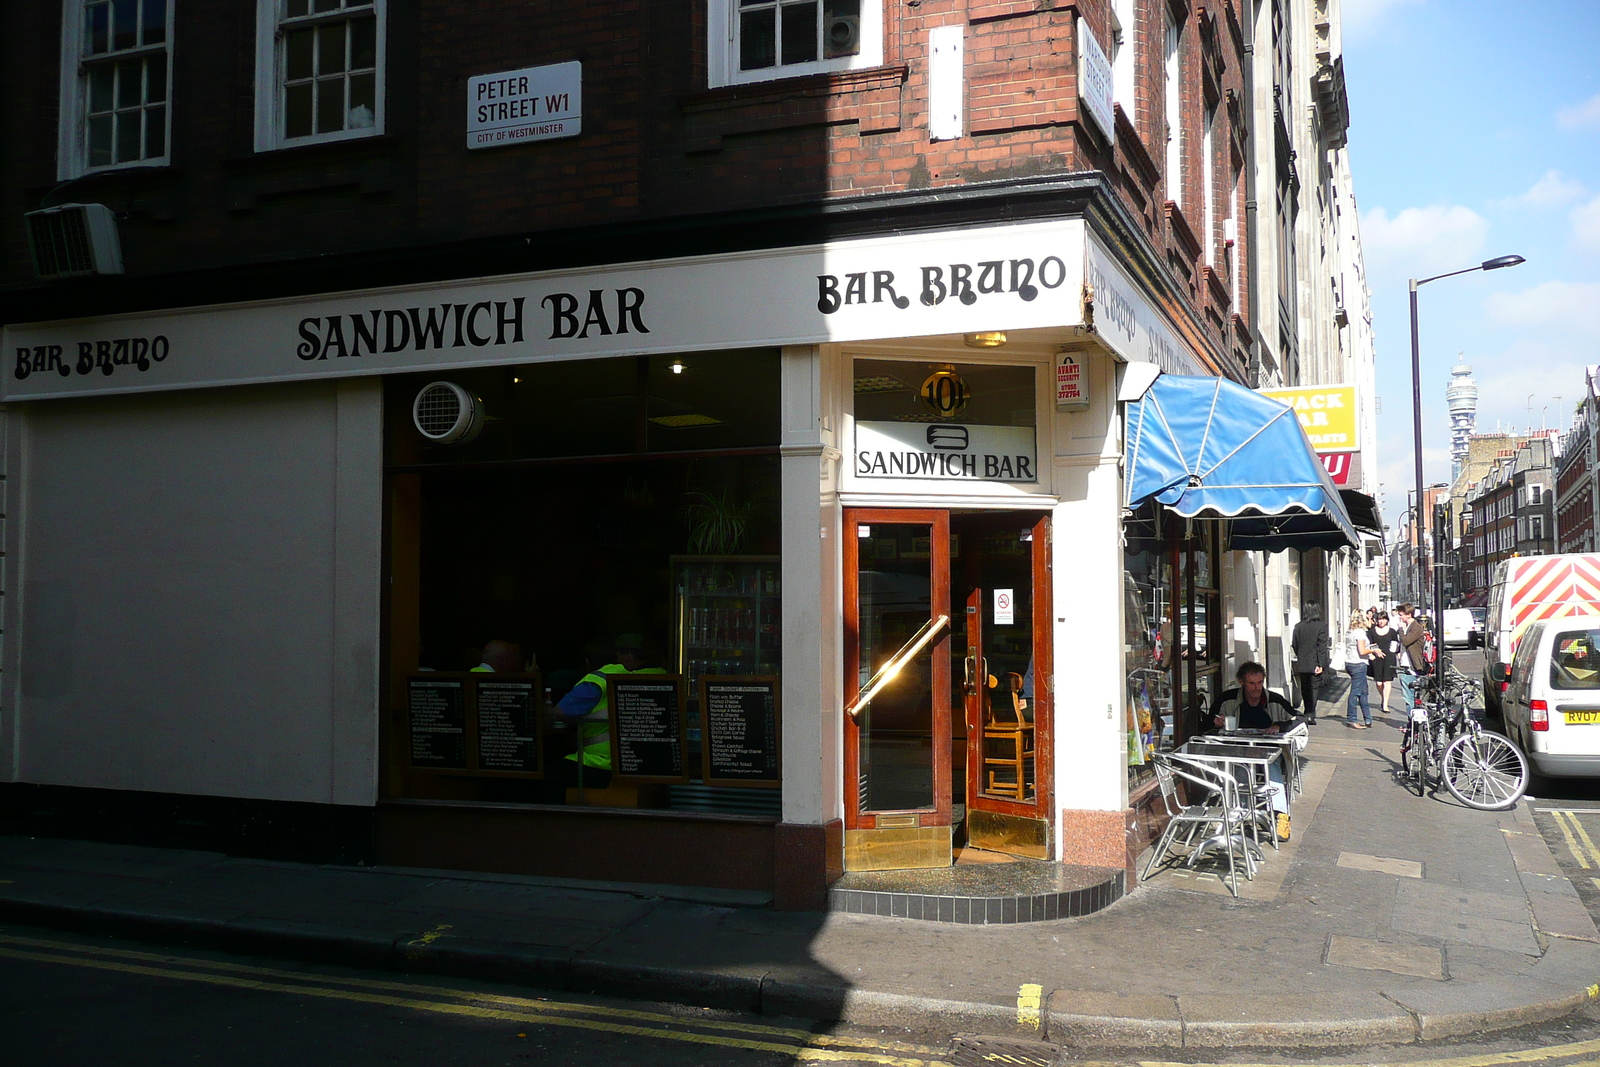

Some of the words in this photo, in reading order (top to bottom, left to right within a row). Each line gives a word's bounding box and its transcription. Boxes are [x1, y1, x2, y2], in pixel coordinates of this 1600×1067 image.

[478, 76, 528, 101] PETER
[1086, 57, 1104, 101] STREET
[478, 97, 539, 123] STREET
[545, 93, 569, 113] W1
[477, 133, 494, 143] CITY
[496, 131, 506, 141] OF
[507, 123, 563, 139] WESTMINSTER
[815, 270, 911, 315] BAR
[919, 255, 1067, 307] BRUNO
[297, 297, 526, 361] SANDWICH
[541, 287, 651, 340] BAR
[14, 345, 71, 380] BAR
[76, 335, 170, 376] BRUNO
[1057, 364, 1080, 375] AVANTI
[1057, 374, 1080, 382] SECURITY
[926, 376, 968, 412] 101
[1272, 393, 1344, 410] NACK
[1299, 411, 1329, 427] AR
[1307, 433, 1347, 444] FASTS
[858, 450, 977, 478] SANDWICH
[984, 454, 1035, 479] BAR
[1568, 711, 1598, 722] RV07
